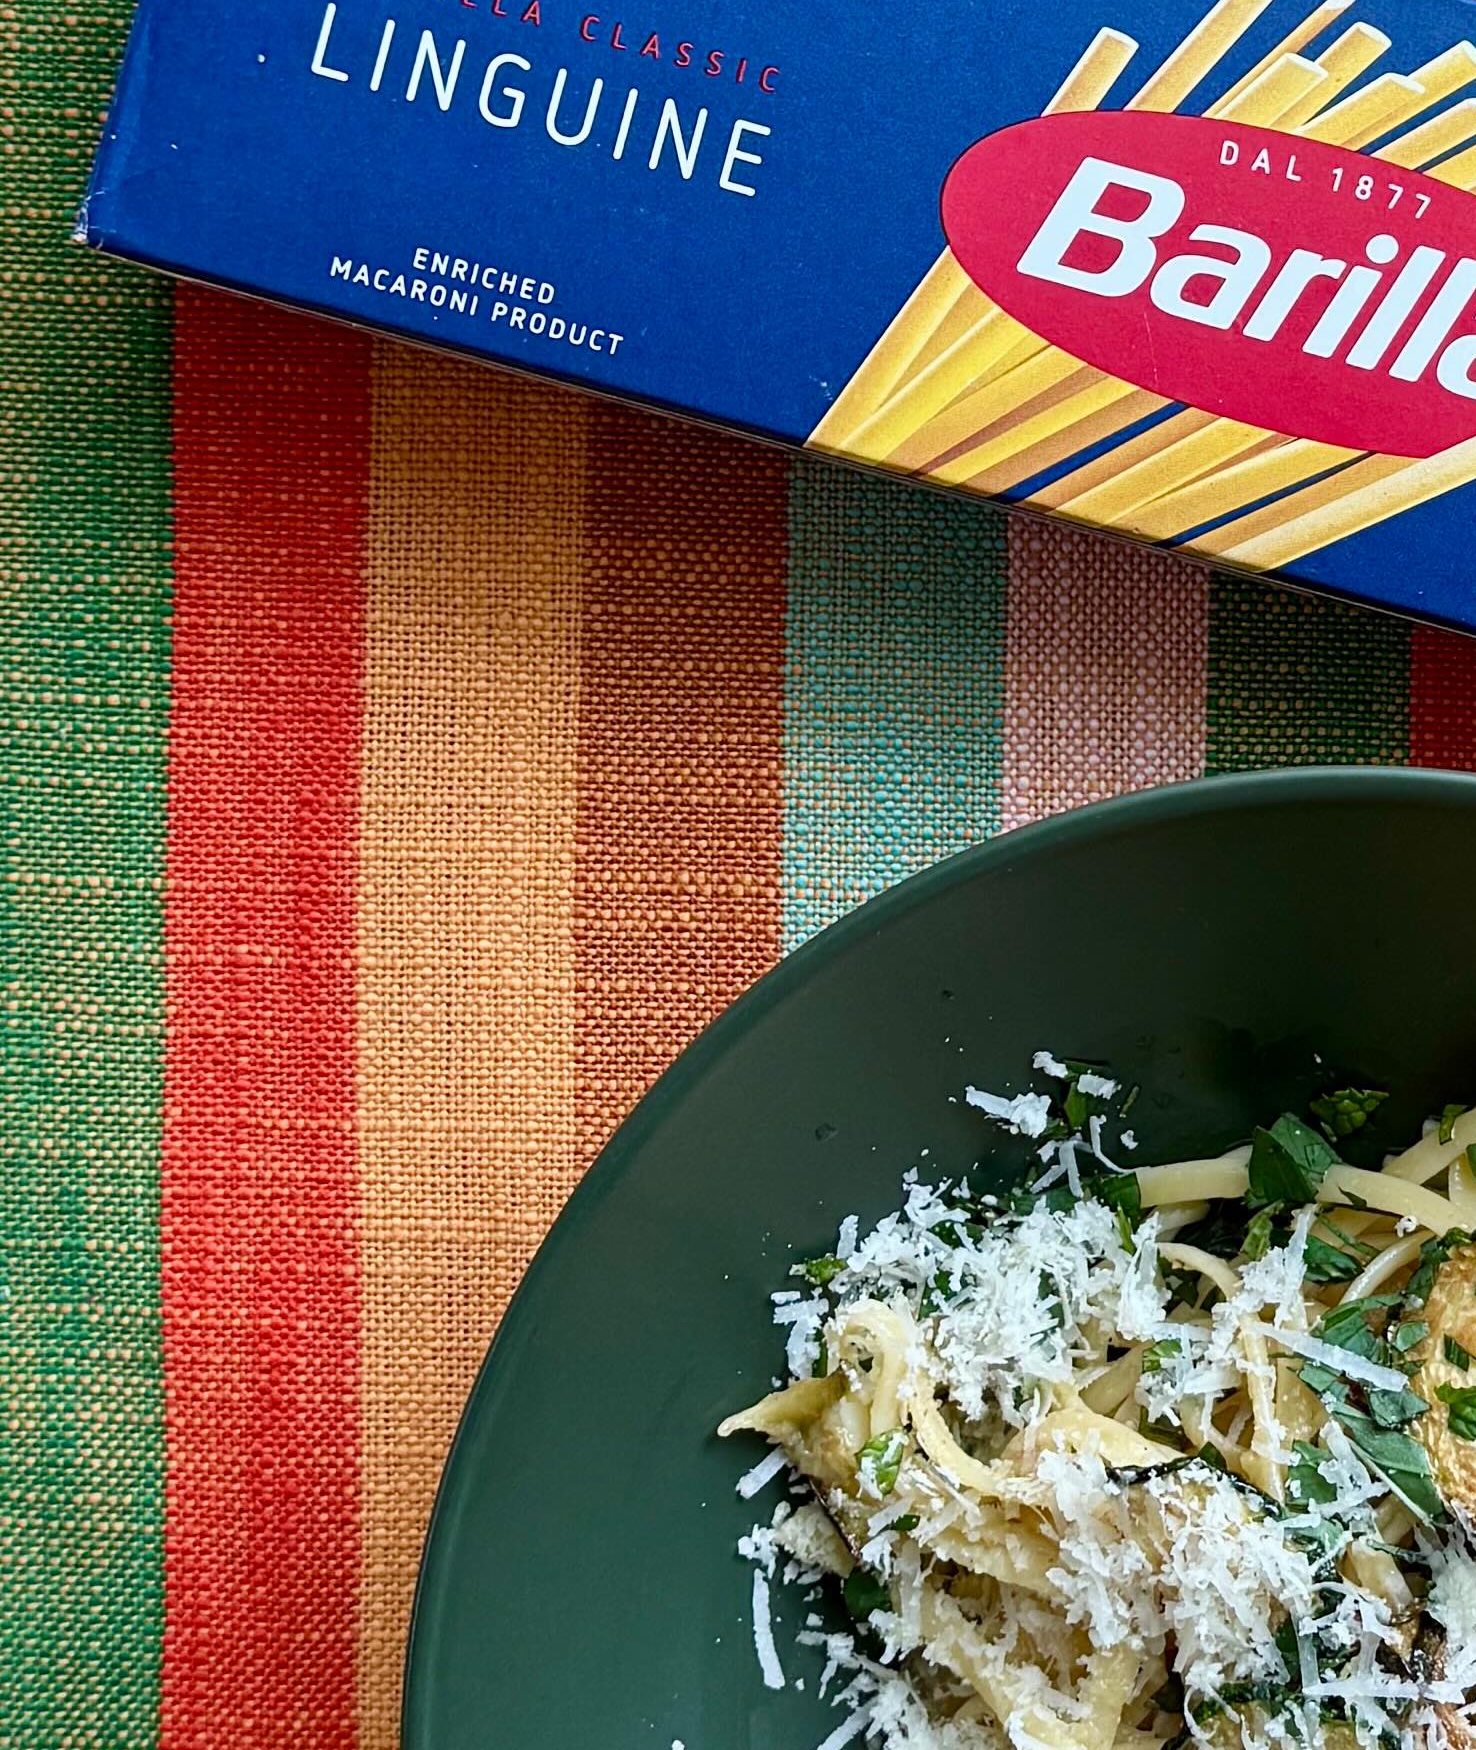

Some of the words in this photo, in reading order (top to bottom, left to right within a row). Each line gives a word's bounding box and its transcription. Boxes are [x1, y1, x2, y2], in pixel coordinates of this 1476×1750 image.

[579, 16, 781, 93] CLASSIC
[310, 2, 772, 198] LINGUINE
[1219, 139, 1303, 182] DAL
[1330, 166, 1433, 220] 1877
[330, 256, 480, 317] MACARONI
[490, 301, 625, 356] PRODUCT
[411, 247, 556, 305] ENRICHED
